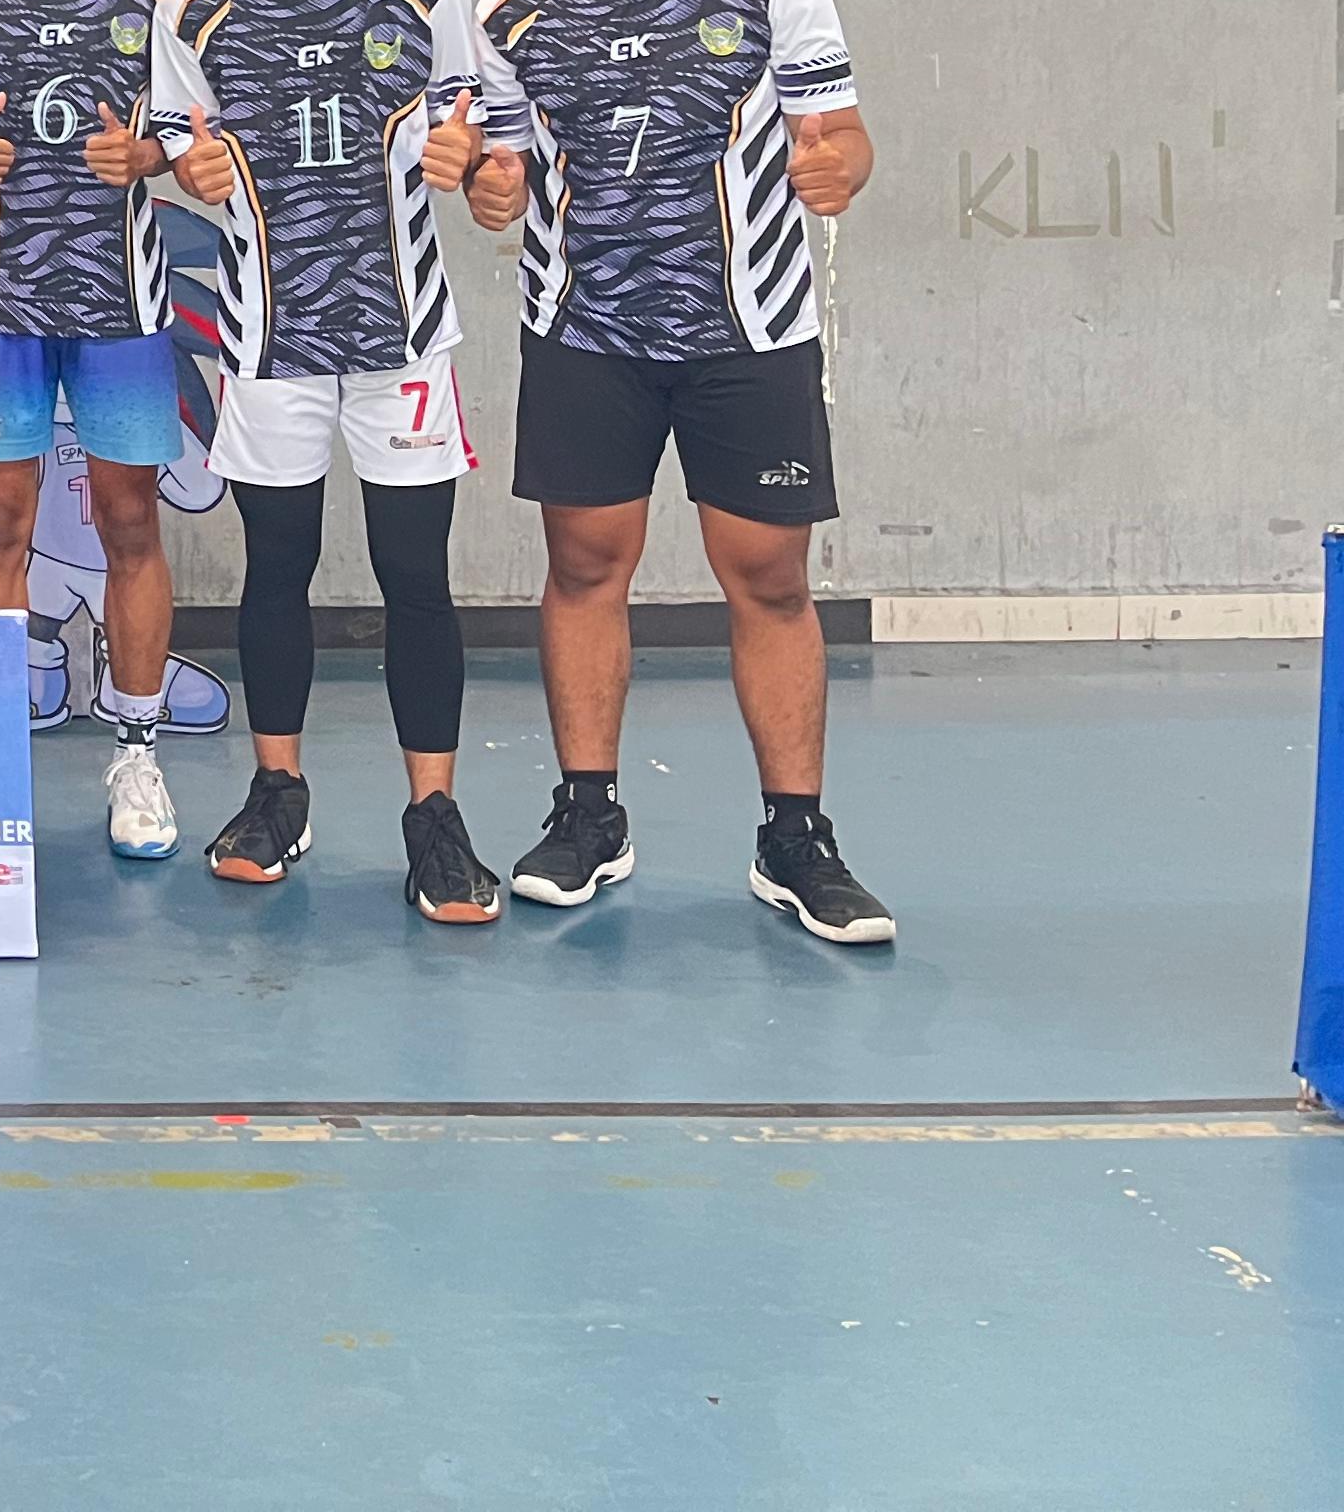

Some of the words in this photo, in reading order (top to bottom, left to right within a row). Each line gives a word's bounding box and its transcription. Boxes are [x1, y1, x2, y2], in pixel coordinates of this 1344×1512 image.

[33, 74, 79, 144] 6
[286, 93, 354, 168] 11
[611, 105, 651, 178] 7
[400, 381, 429, 431] 7
